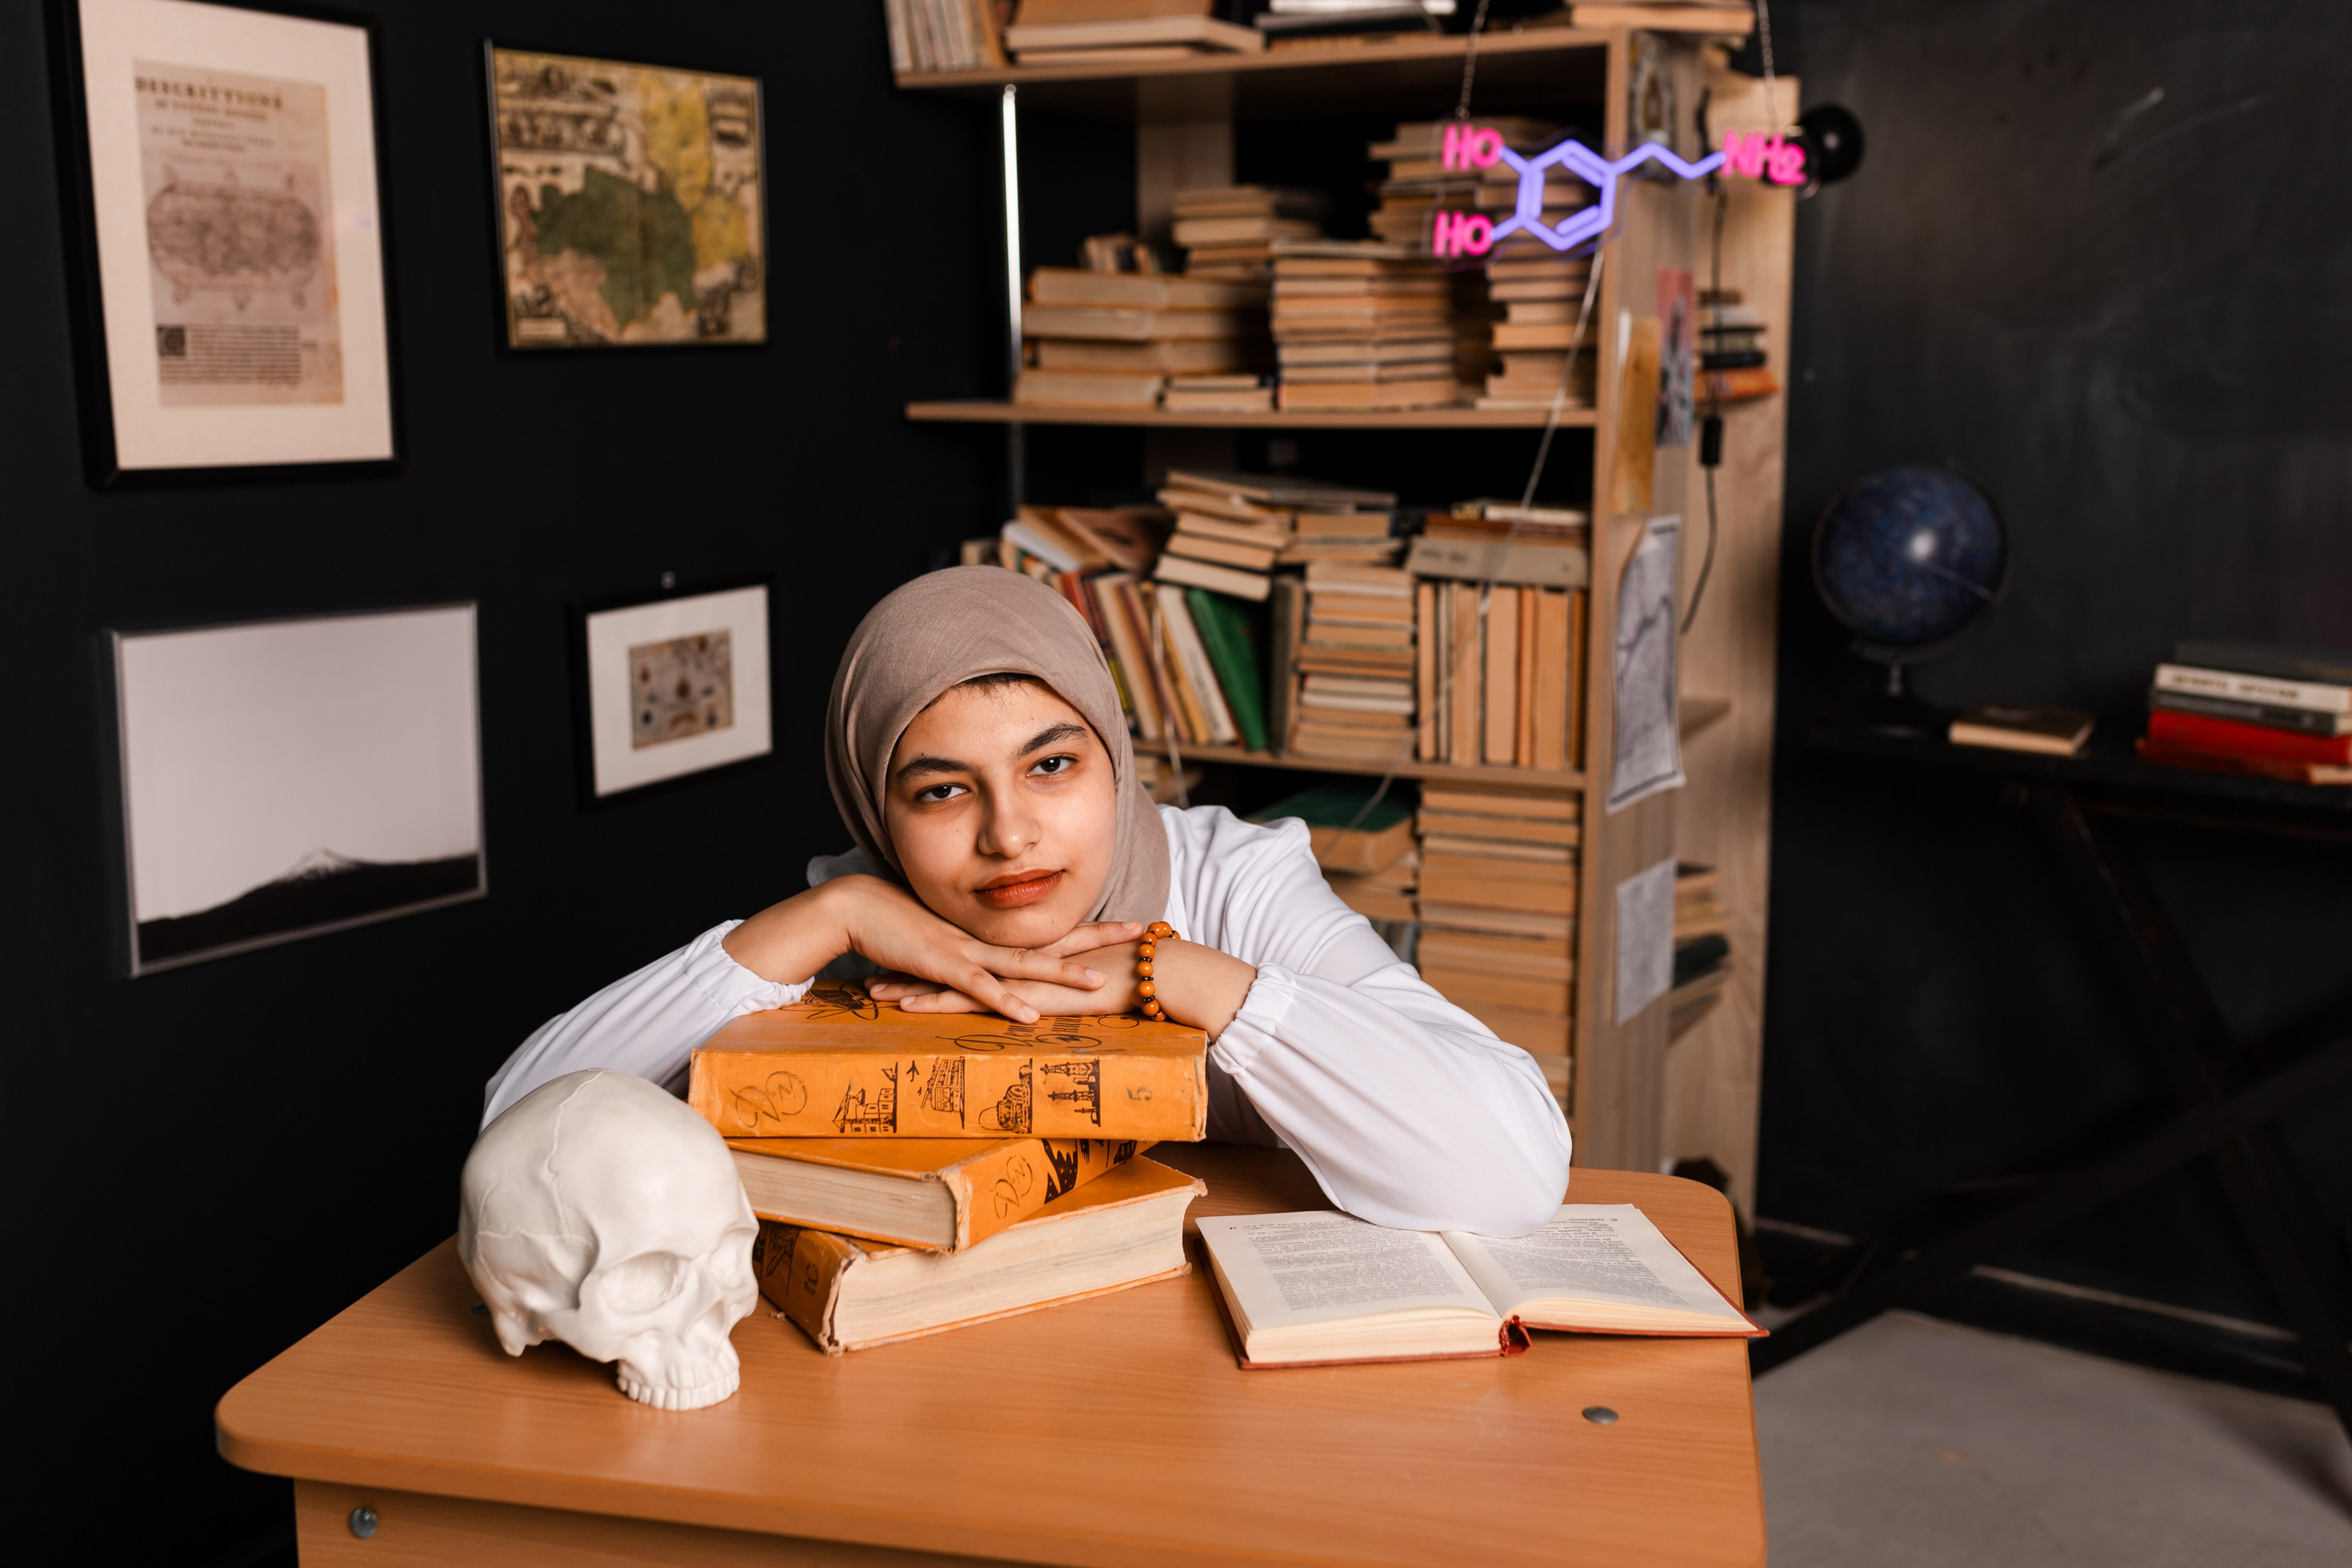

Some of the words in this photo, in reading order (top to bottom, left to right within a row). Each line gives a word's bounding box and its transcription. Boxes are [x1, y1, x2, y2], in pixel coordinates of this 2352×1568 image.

[1442, 124, 1504, 171] HO
[1432, 209, 1494, 258] HO
[1125, 1085, 1153, 1101] 5
